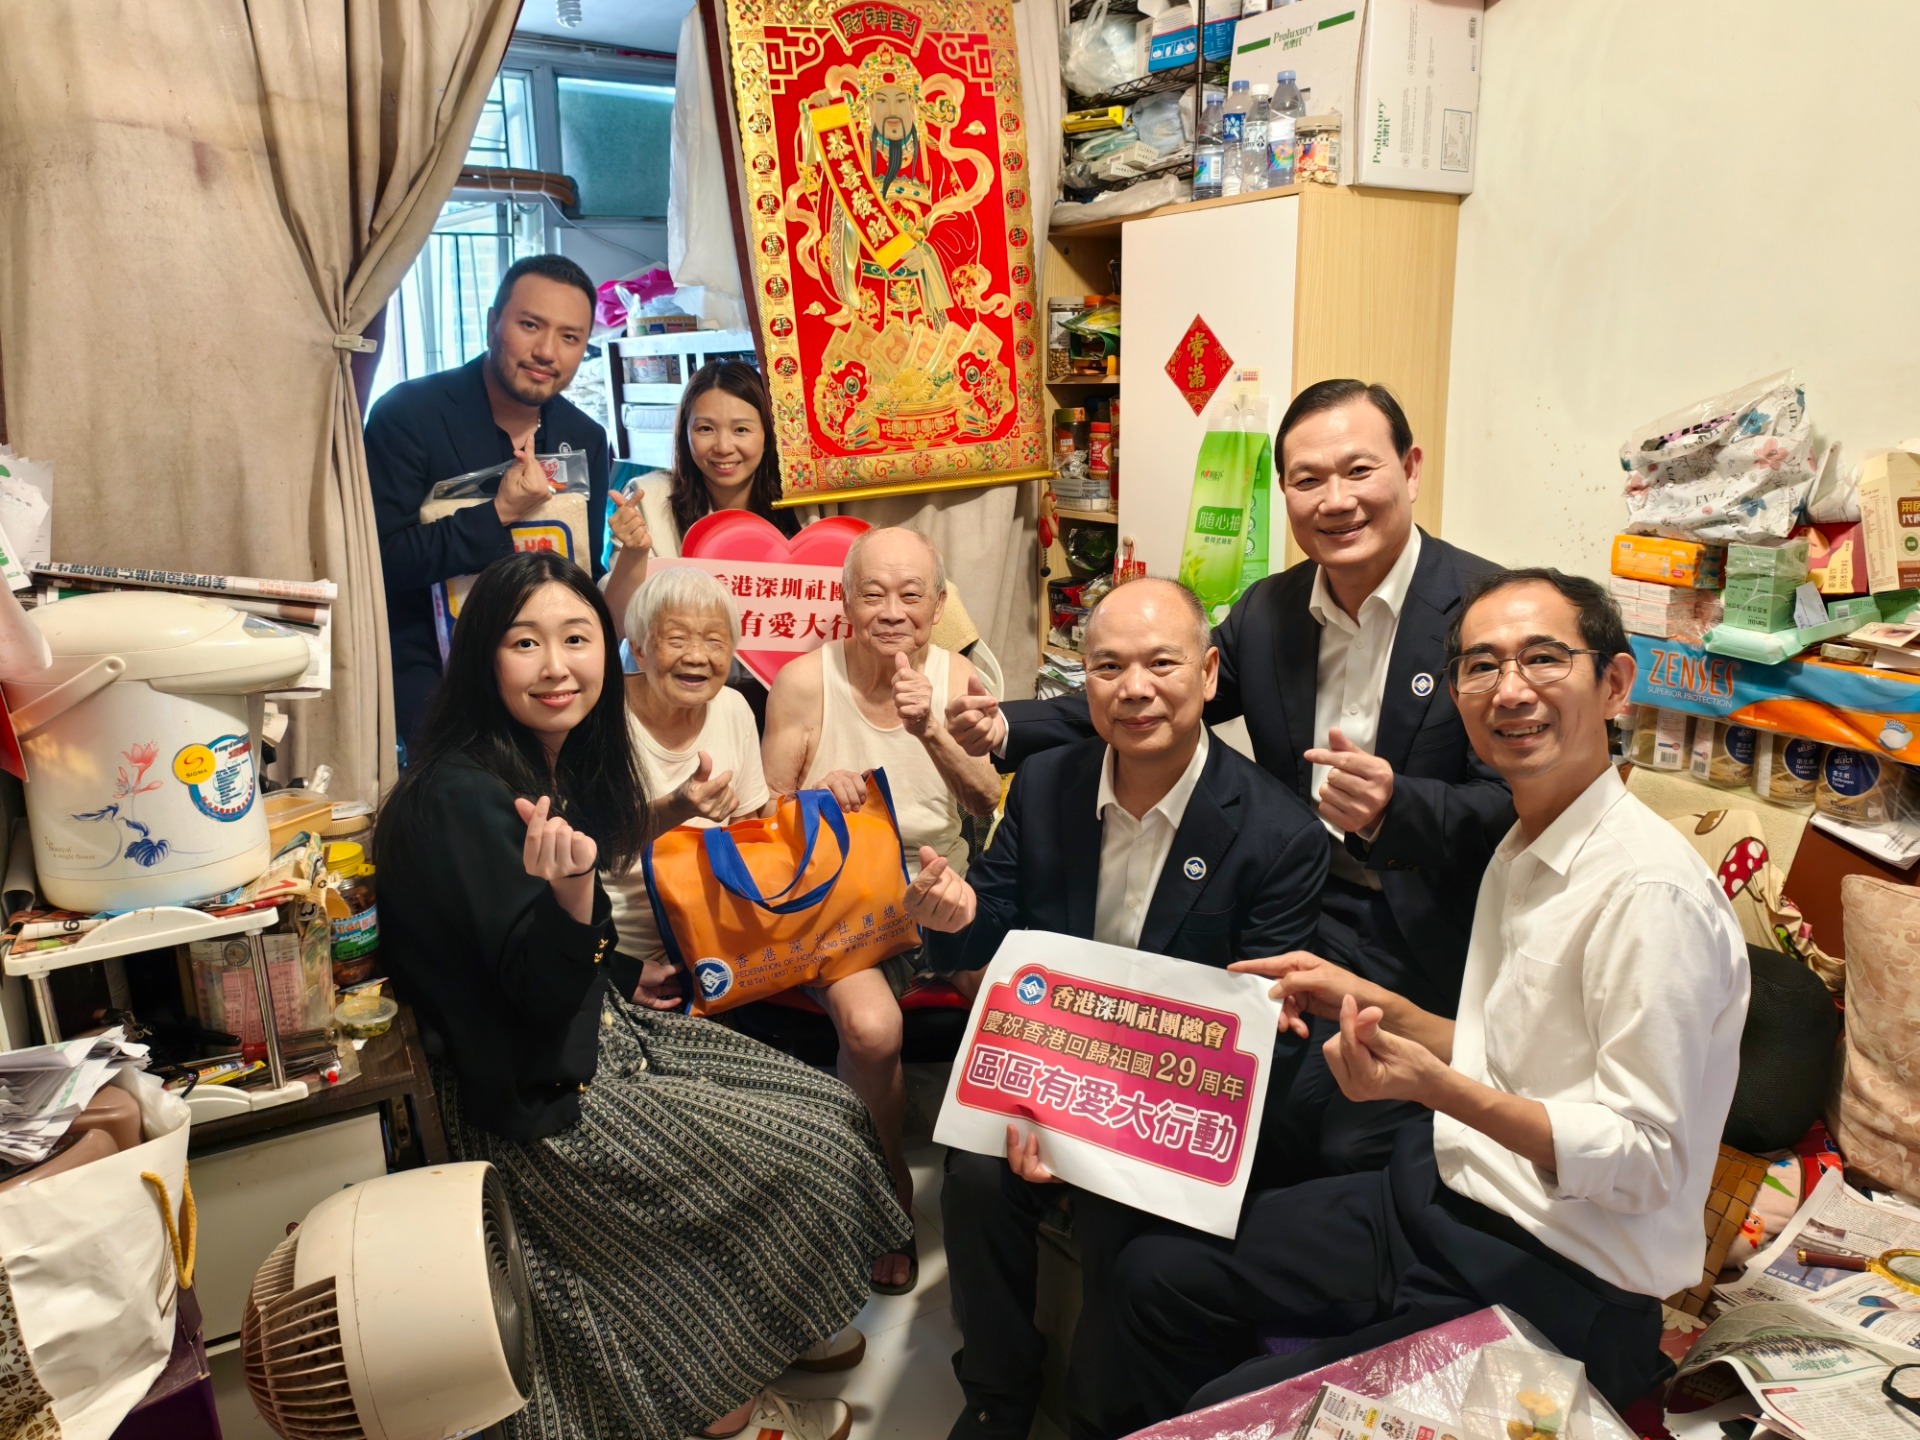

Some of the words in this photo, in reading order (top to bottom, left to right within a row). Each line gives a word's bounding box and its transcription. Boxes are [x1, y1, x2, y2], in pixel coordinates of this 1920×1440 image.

[840, 7, 917, 37] 財神到
[1273, 22, 1316, 42] Proluxury
[1373, 100, 1386, 163] Proluxury
[826, 128, 895, 248] 恭喜發財
[1187, 331, 1210, 389] 常滿
[1199, 511, 1241, 531] 随心抽
[713, 574, 844, 602] 港深圳社團
[1649, 649, 1734, 698] ZENSES
[1648, 686, 1682, 698] SUPERIOR
[1684, 692, 1733, 708] PROTECTION
[186, 768, 208, 778] SIGMA
[735, 961, 781, 979] FEDERATION
[783, 957, 793, 966] OF
[1050, 984, 1229, 1049] 香港深圳社團總會
[966, 1044, 1238, 1164] 區區有愛大行動
